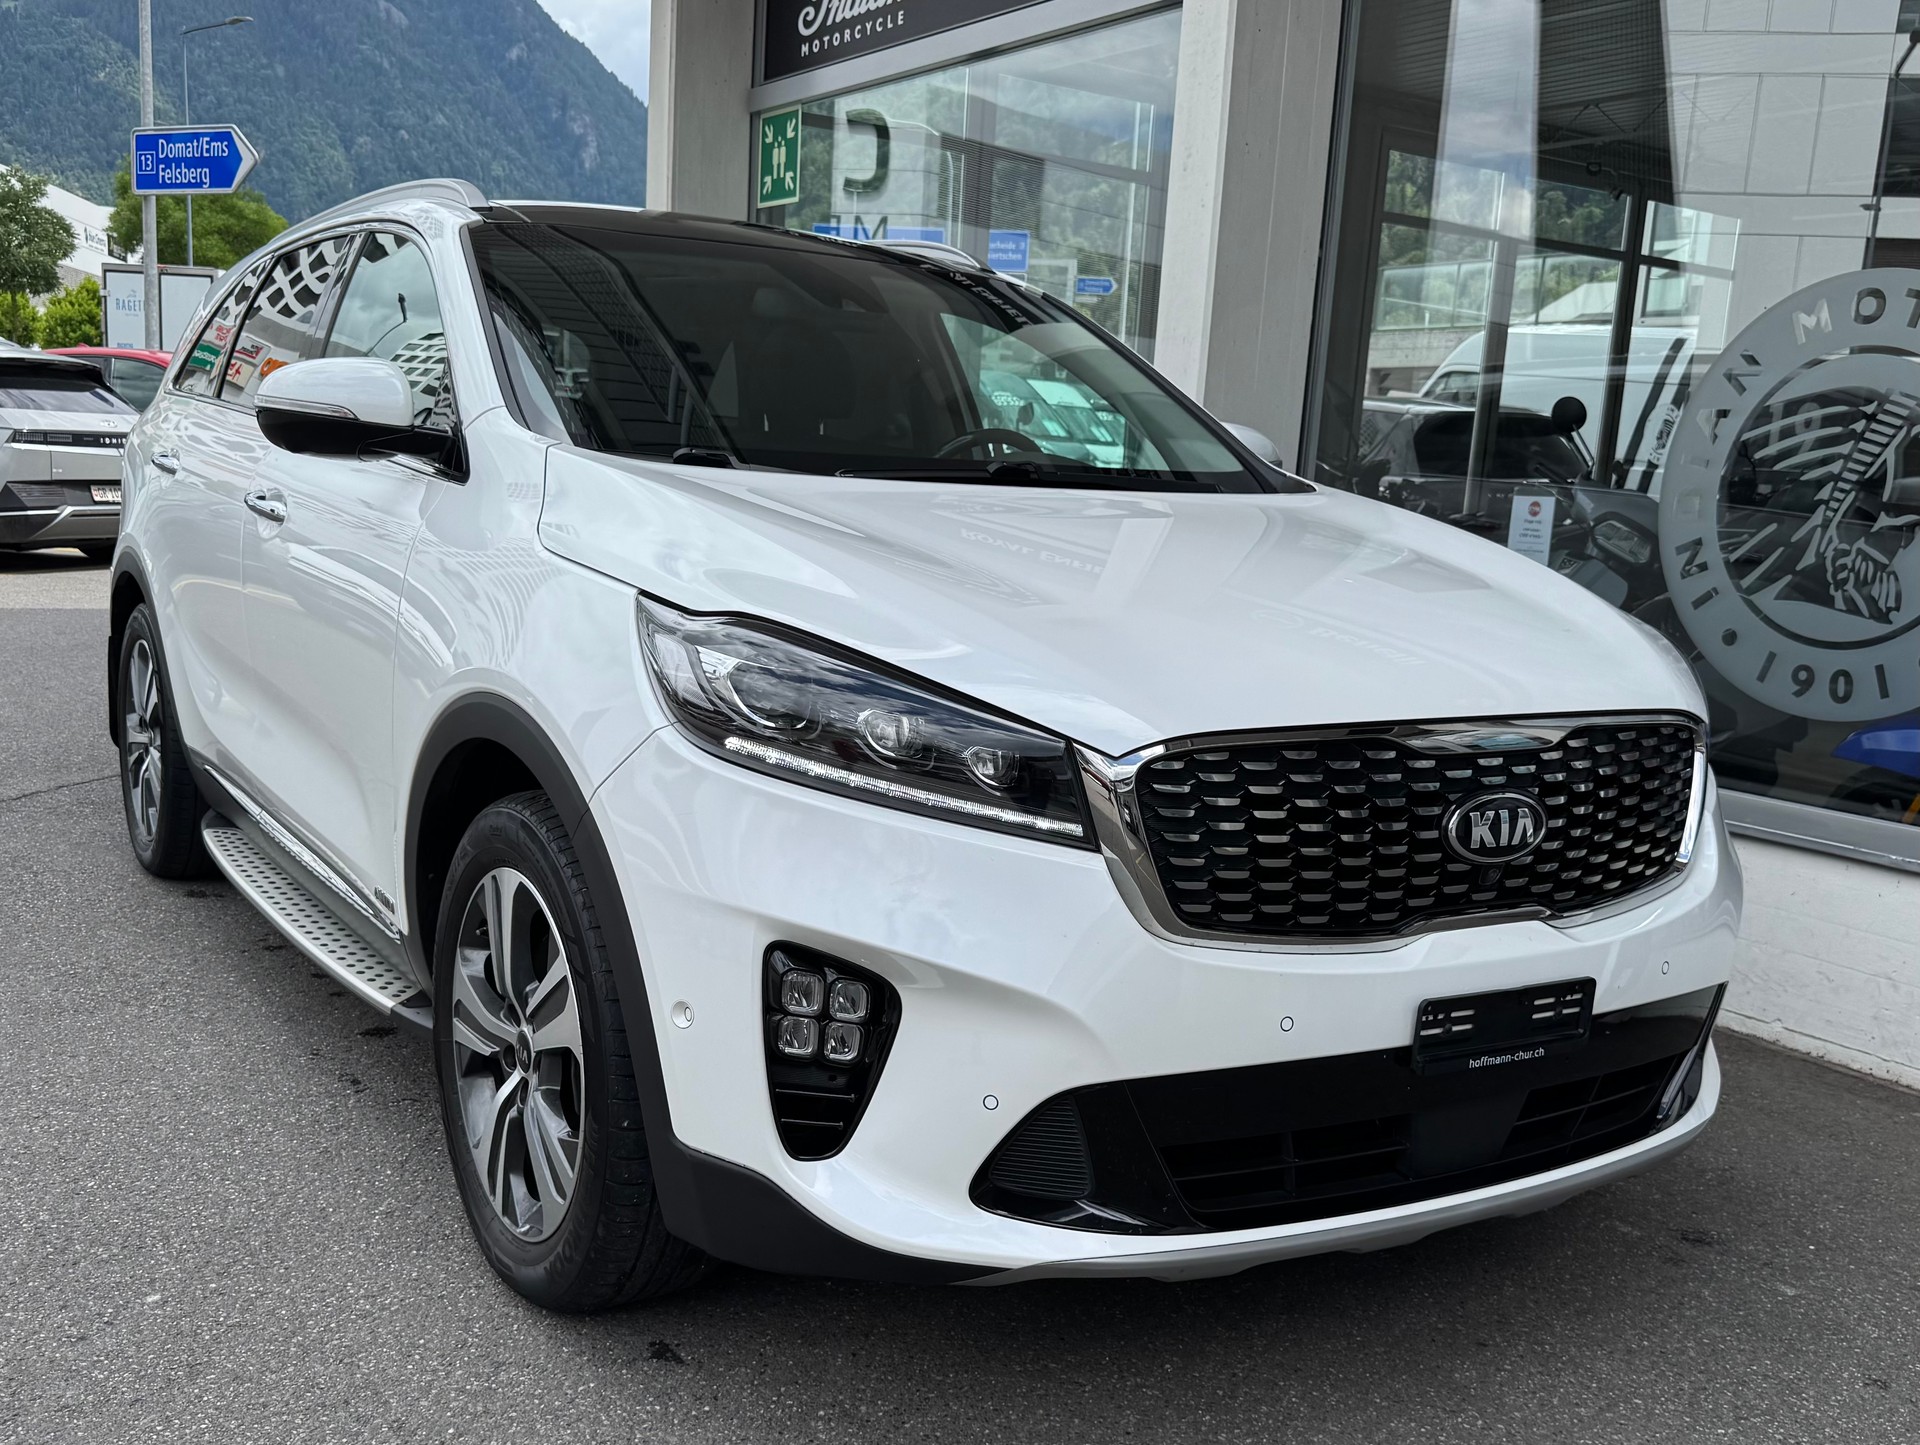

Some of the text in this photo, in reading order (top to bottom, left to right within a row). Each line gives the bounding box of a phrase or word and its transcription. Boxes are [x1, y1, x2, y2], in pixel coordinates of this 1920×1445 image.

[798, 0, 901, 36] Indi
[801, 10, 905, 57] MOTORCYCLE
[140, 154, 153, 171] 13
[158, 137, 229, 159] Domat/Ems
[158, 163, 210, 188] Felsberg
[1791, 287, 1920, 346] MOT
[1756, 650, 1890, 705] 1901
[1469, 808, 1534, 849] KIA
[1468, 1047, 1545, 1069] hoffmann-chur.ch
